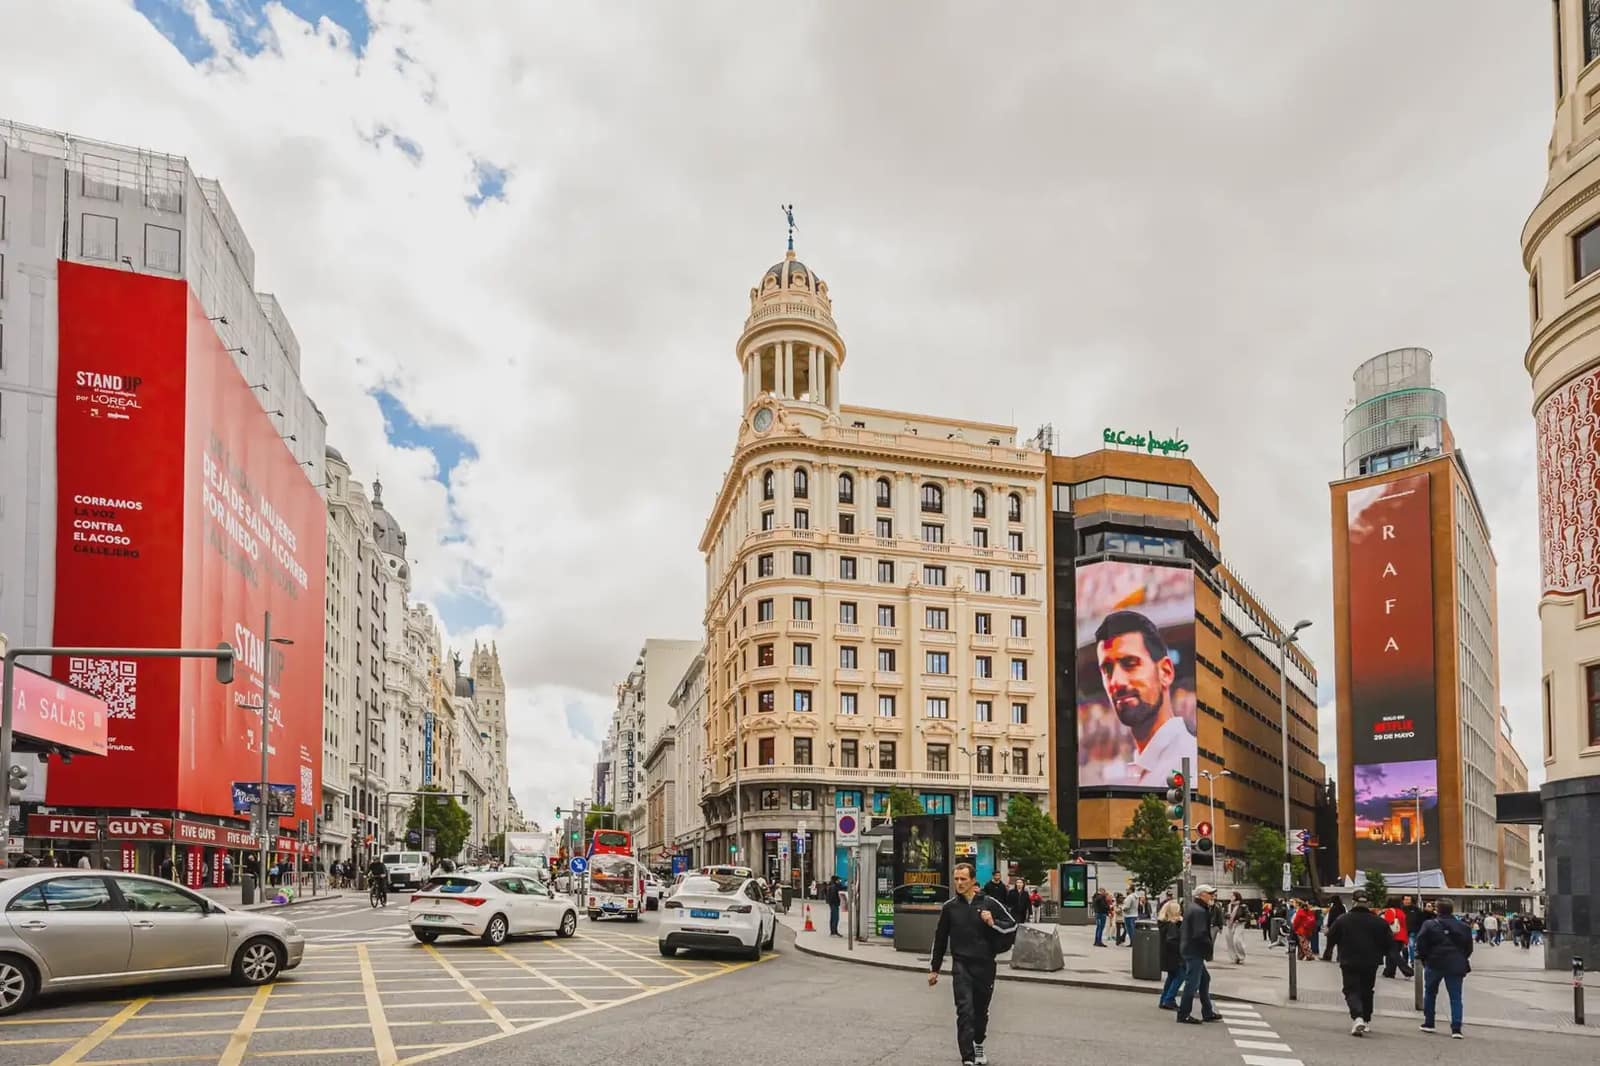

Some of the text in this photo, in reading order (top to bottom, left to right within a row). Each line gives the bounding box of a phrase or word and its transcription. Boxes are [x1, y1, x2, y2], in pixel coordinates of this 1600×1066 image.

[76, 371, 122, 390] STAND
[123, 376, 142, 393] UP
[1116, 431, 1146, 447] Corte
[203, 450, 230, 503] DEJA
[231, 486, 245, 519] DE
[74, 495, 143, 511] CORRAMOS
[73, 520, 123, 533] CONTRA
[203, 482, 225, 528] POR
[225, 511, 258, 560] MIEDO
[260, 496, 297, 553] MUJERES
[73, 532, 131, 545] EL ACOSO
[40, 698, 86, 731] SALAS
[50, 820, 165, 835] FIVE GUYS
[181, 824, 216, 841] FIVE GUYS
[227, 831, 240, 844] FIVE
